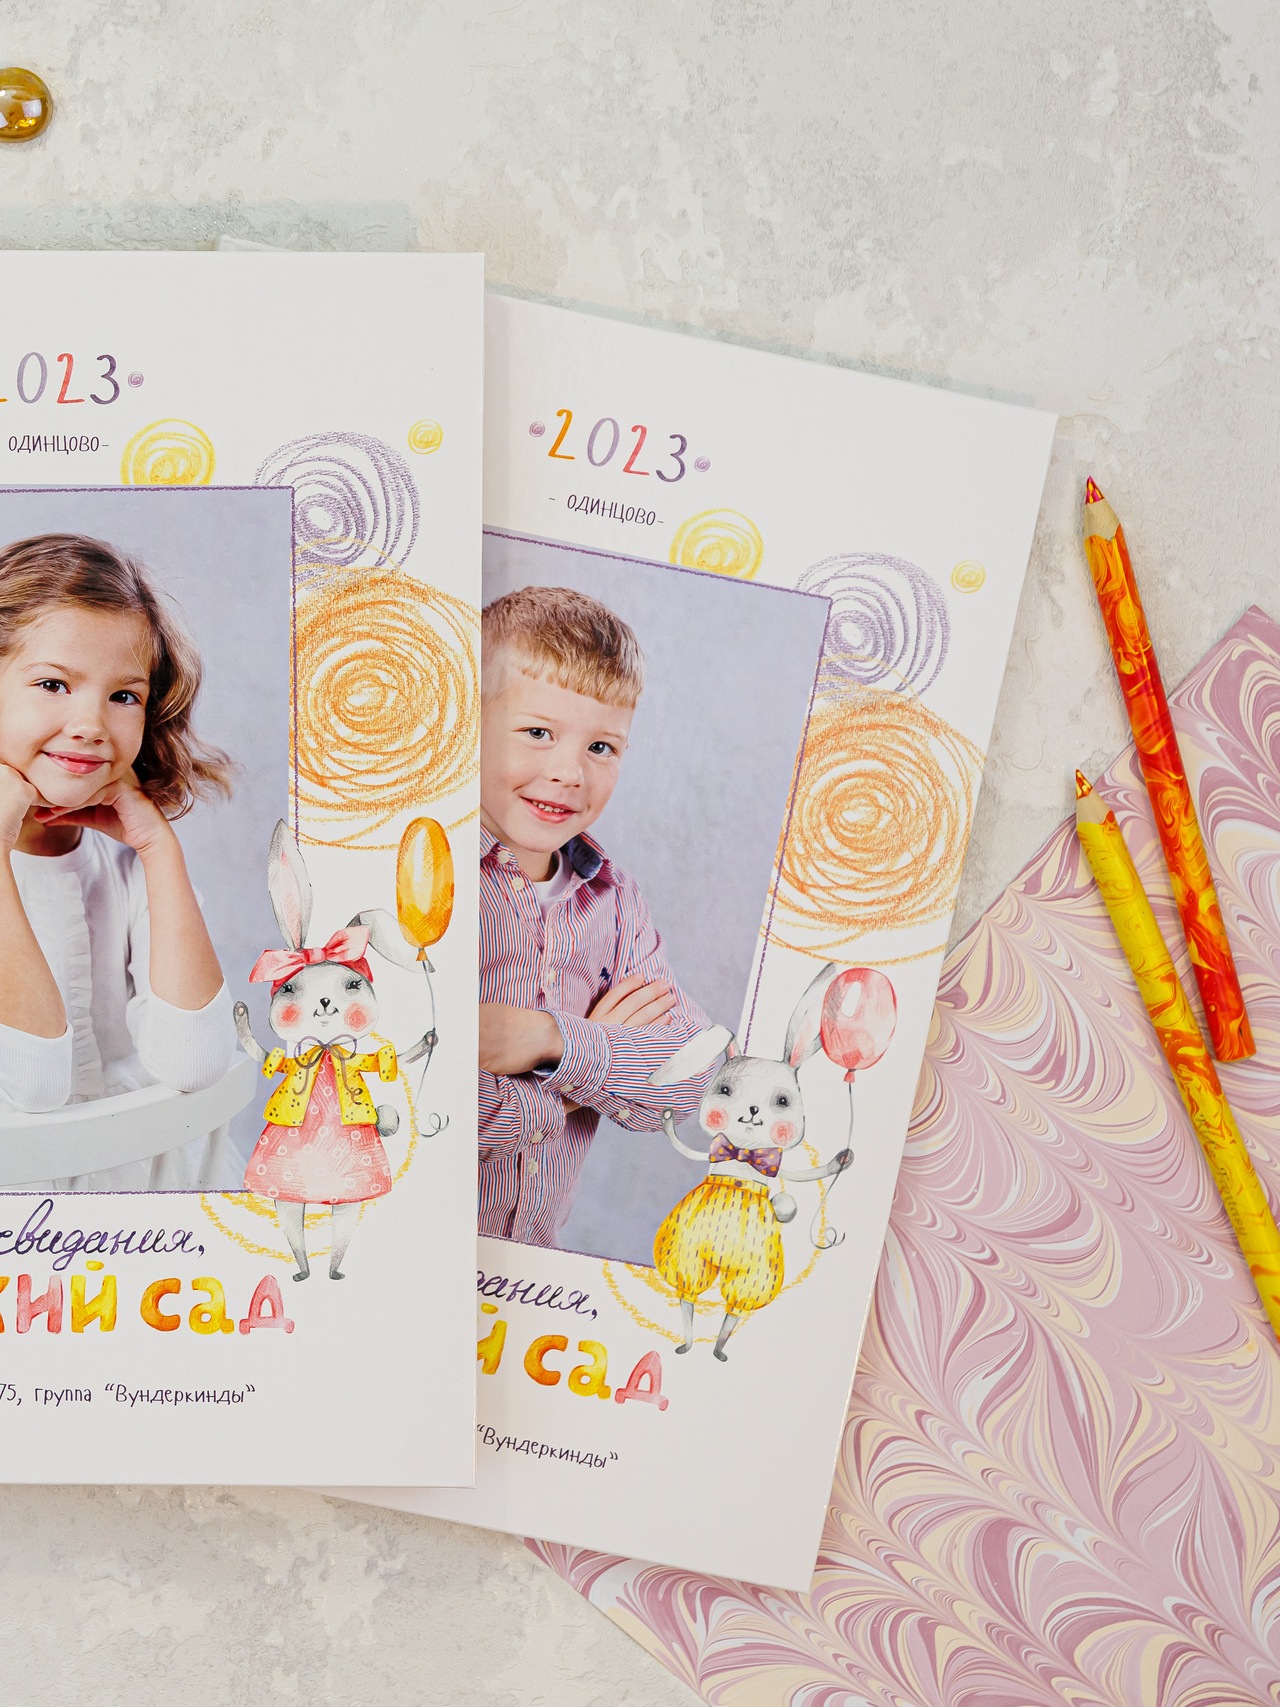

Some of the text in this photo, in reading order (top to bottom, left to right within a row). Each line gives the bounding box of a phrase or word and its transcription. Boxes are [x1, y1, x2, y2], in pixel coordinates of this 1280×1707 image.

[548, 409, 688, 482] 2023
[34, 1387, 92, 1408] группа
[104, 1382, 256, 1408] “Вундеркинды”
